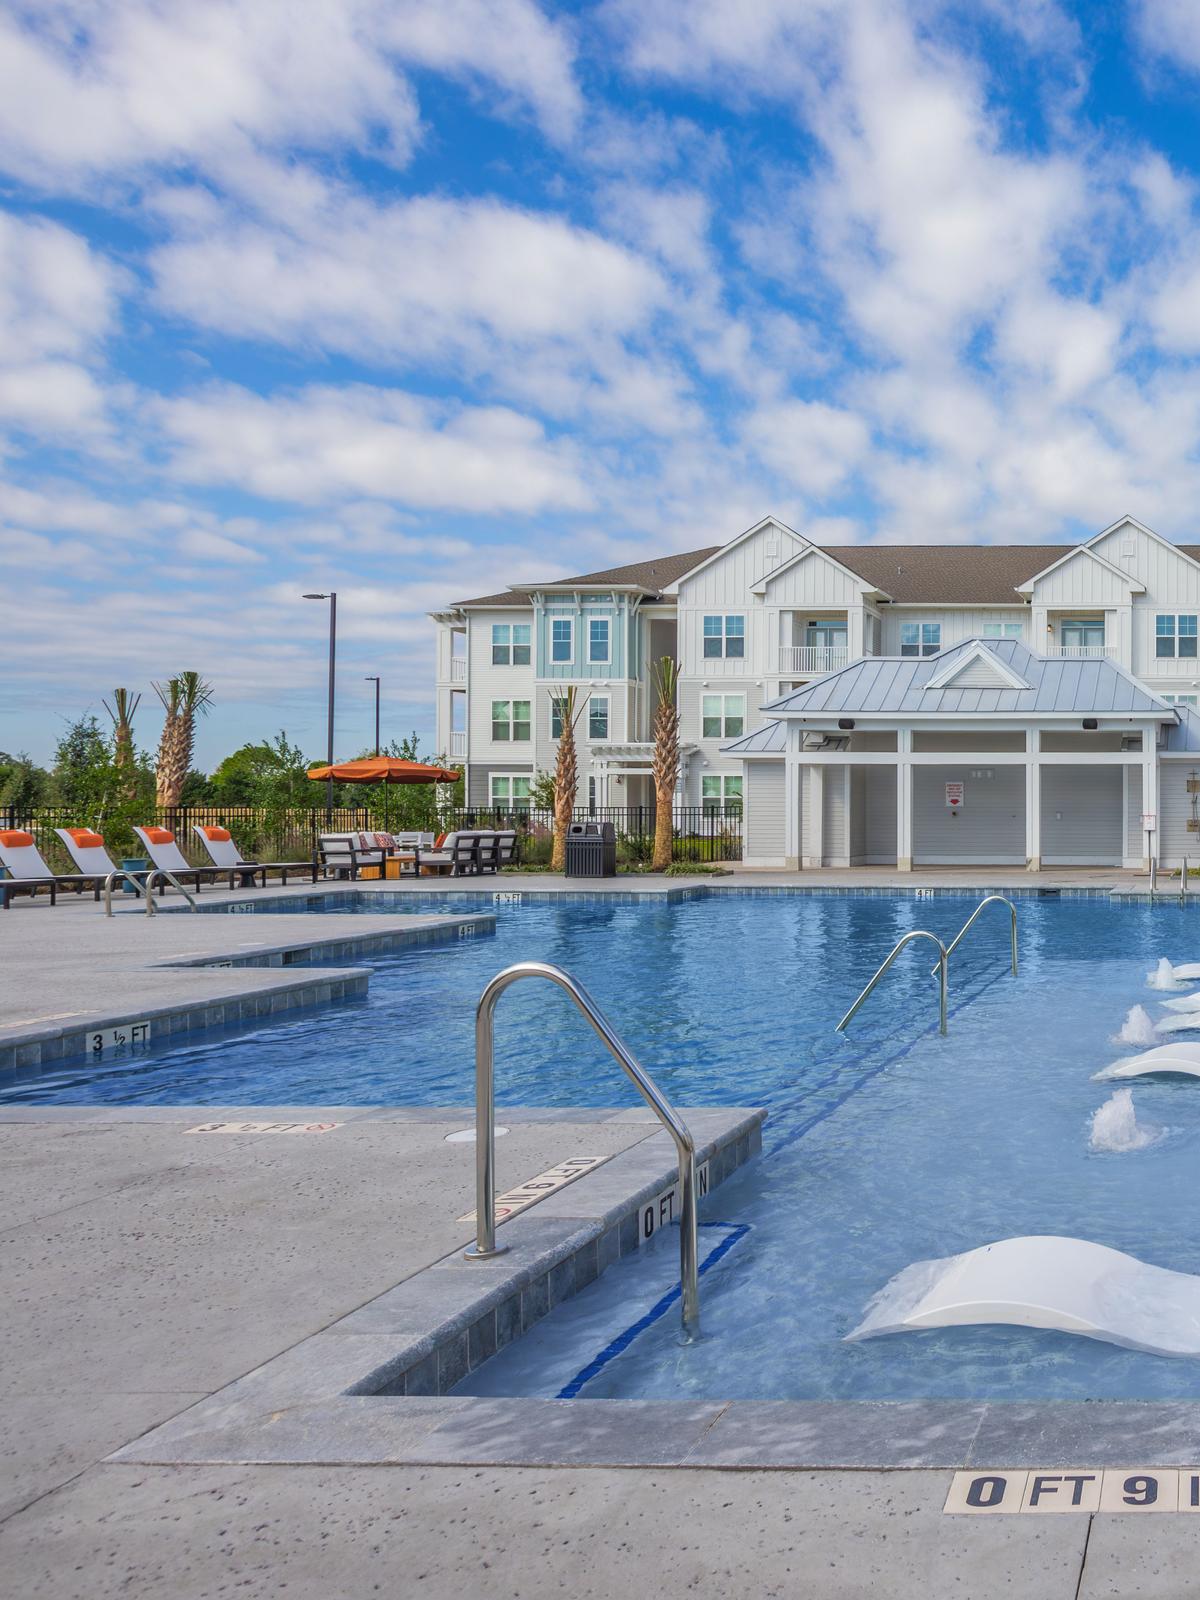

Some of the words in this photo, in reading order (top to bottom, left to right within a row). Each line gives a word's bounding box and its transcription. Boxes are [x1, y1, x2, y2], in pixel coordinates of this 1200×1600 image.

[93, 1034, 103, 1051] 3
[131, 1024, 148, 1047] FT
[198, 1123, 227, 1132] 3
[261, 1123, 304, 1132] FT
[543, 1168, 582, 1179] FT
[496, 1193, 537, 1205] IN
[644, 1206, 654, 1238] 0
[660, 1190, 675, 1227] FT
[965, 1476, 1007, 1507] 0
[1029, 1475, 1096, 1506] FT
[1122, 1475, 1158, 1506] 9
